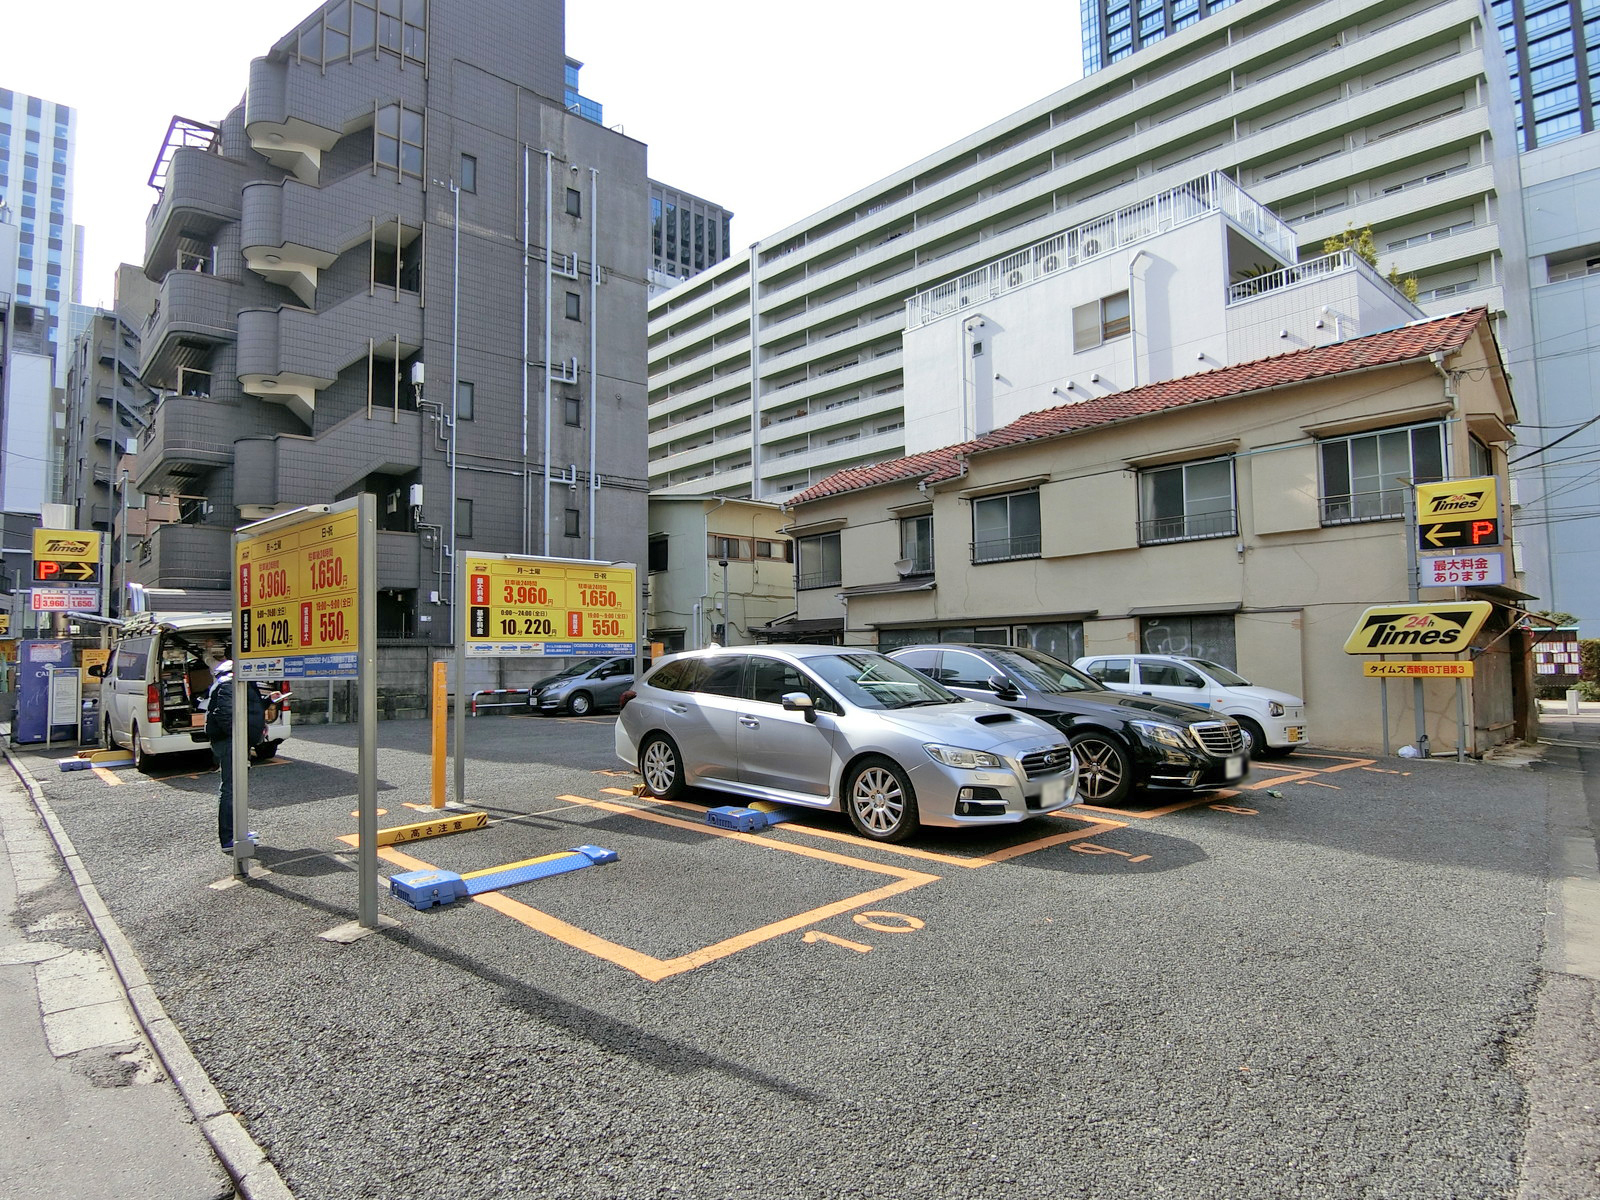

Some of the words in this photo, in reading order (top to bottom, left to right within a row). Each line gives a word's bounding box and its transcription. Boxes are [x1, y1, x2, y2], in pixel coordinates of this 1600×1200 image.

[1432, 499, 1478, 512] Times
[1472, 521, 1494, 544] P
[47, 543, 86, 552] Times
[39, 561, 59, 580] P
[1433, 558, 1488, 571] 最大料金
[1433, 570, 1488, 583] あります
[503, 586, 553, 606] 3,960円
[580, 590, 622, 608] 1,650円
[320, 610, 349, 642] 550円
[592, 620, 625, 636] 550円
[1404, 615, 1434, 628] 24h
[1367, 624, 1461, 648] Times
[411, 821, 462, 838] 高さ注意
[801, 910, 926, 953] 10
